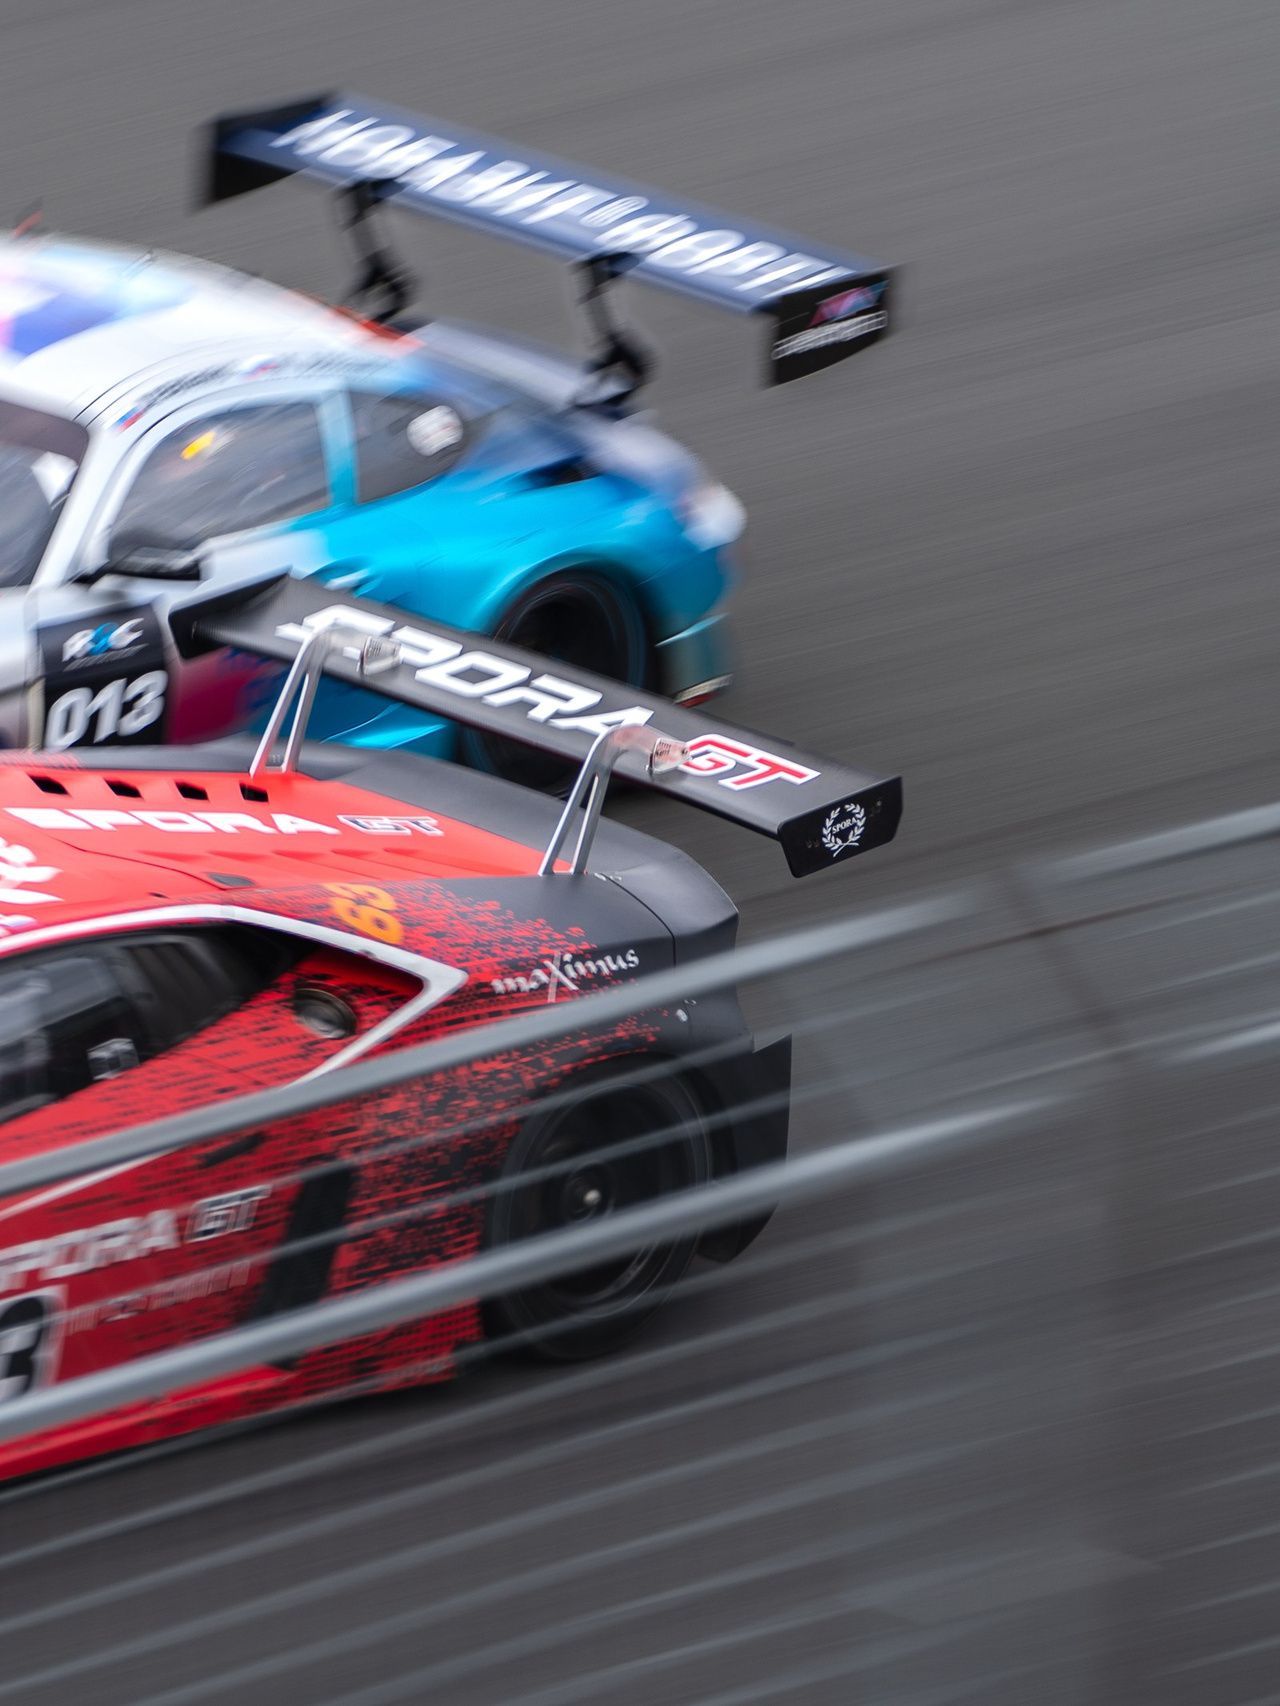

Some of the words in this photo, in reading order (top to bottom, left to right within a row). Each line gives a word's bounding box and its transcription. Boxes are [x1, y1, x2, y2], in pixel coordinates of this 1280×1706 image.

[42, 669, 169, 752] 013
[675, 733, 822, 792] GT
[2, 806, 343, 836] SPORA
[336, 813, 446, 837] GT
[831, 816, 858, 835] SPORA
